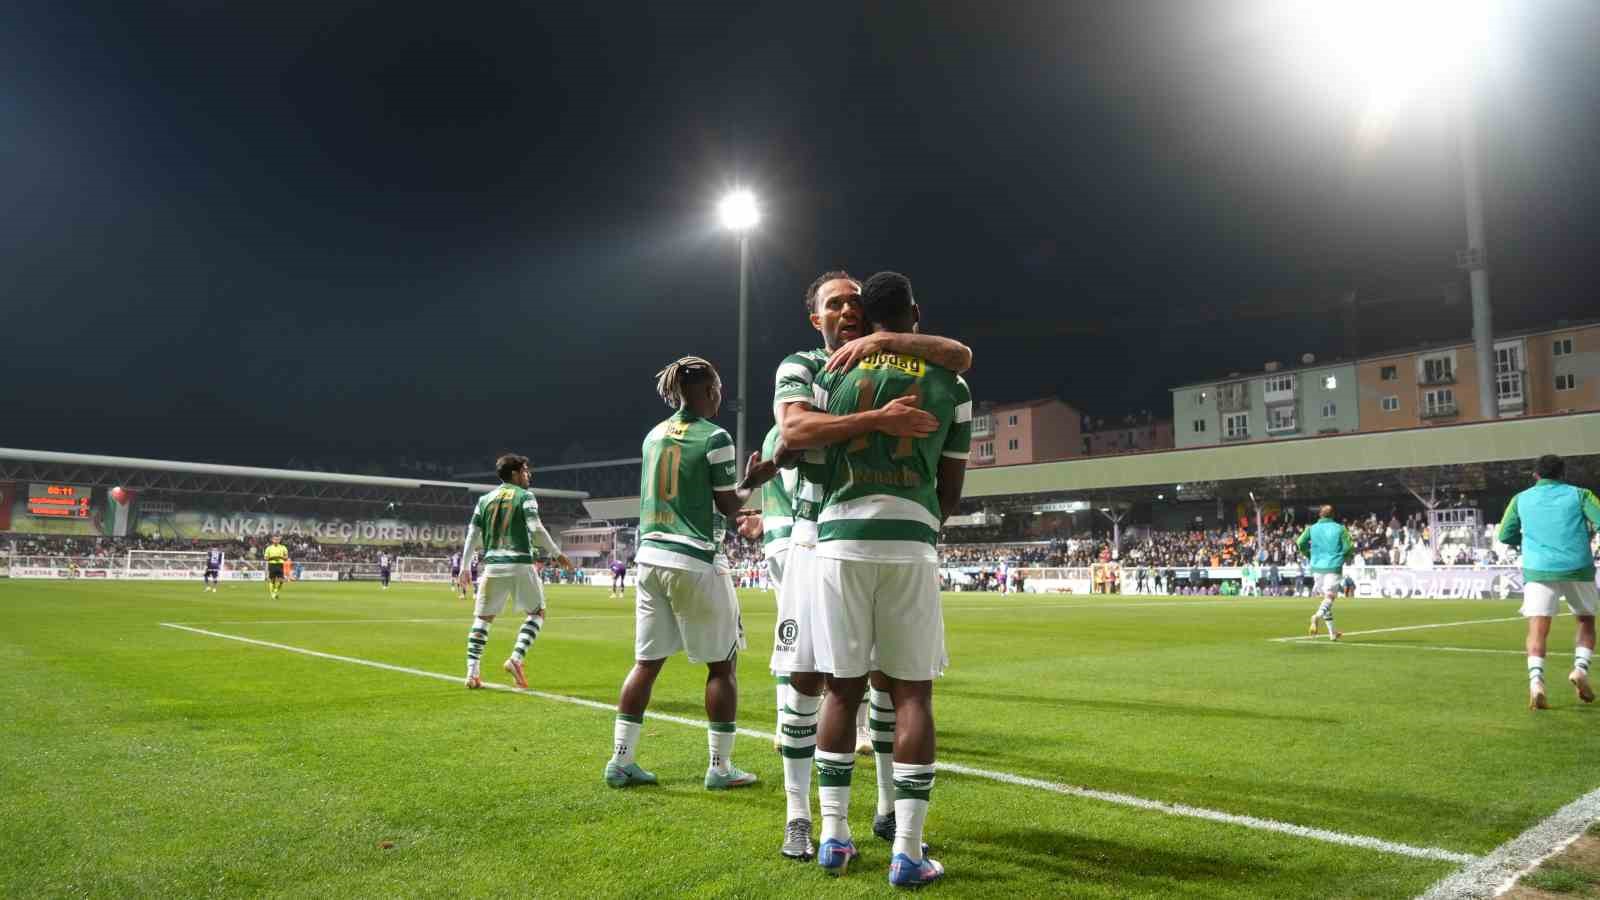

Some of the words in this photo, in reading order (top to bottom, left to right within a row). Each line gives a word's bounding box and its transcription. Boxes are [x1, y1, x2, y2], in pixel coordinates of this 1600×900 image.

[646, 445, 681, 502] 10
[201, 515, 304, 538] ANKARA
[310, 518, 465, 544] KEÇİÖRENGÜC
